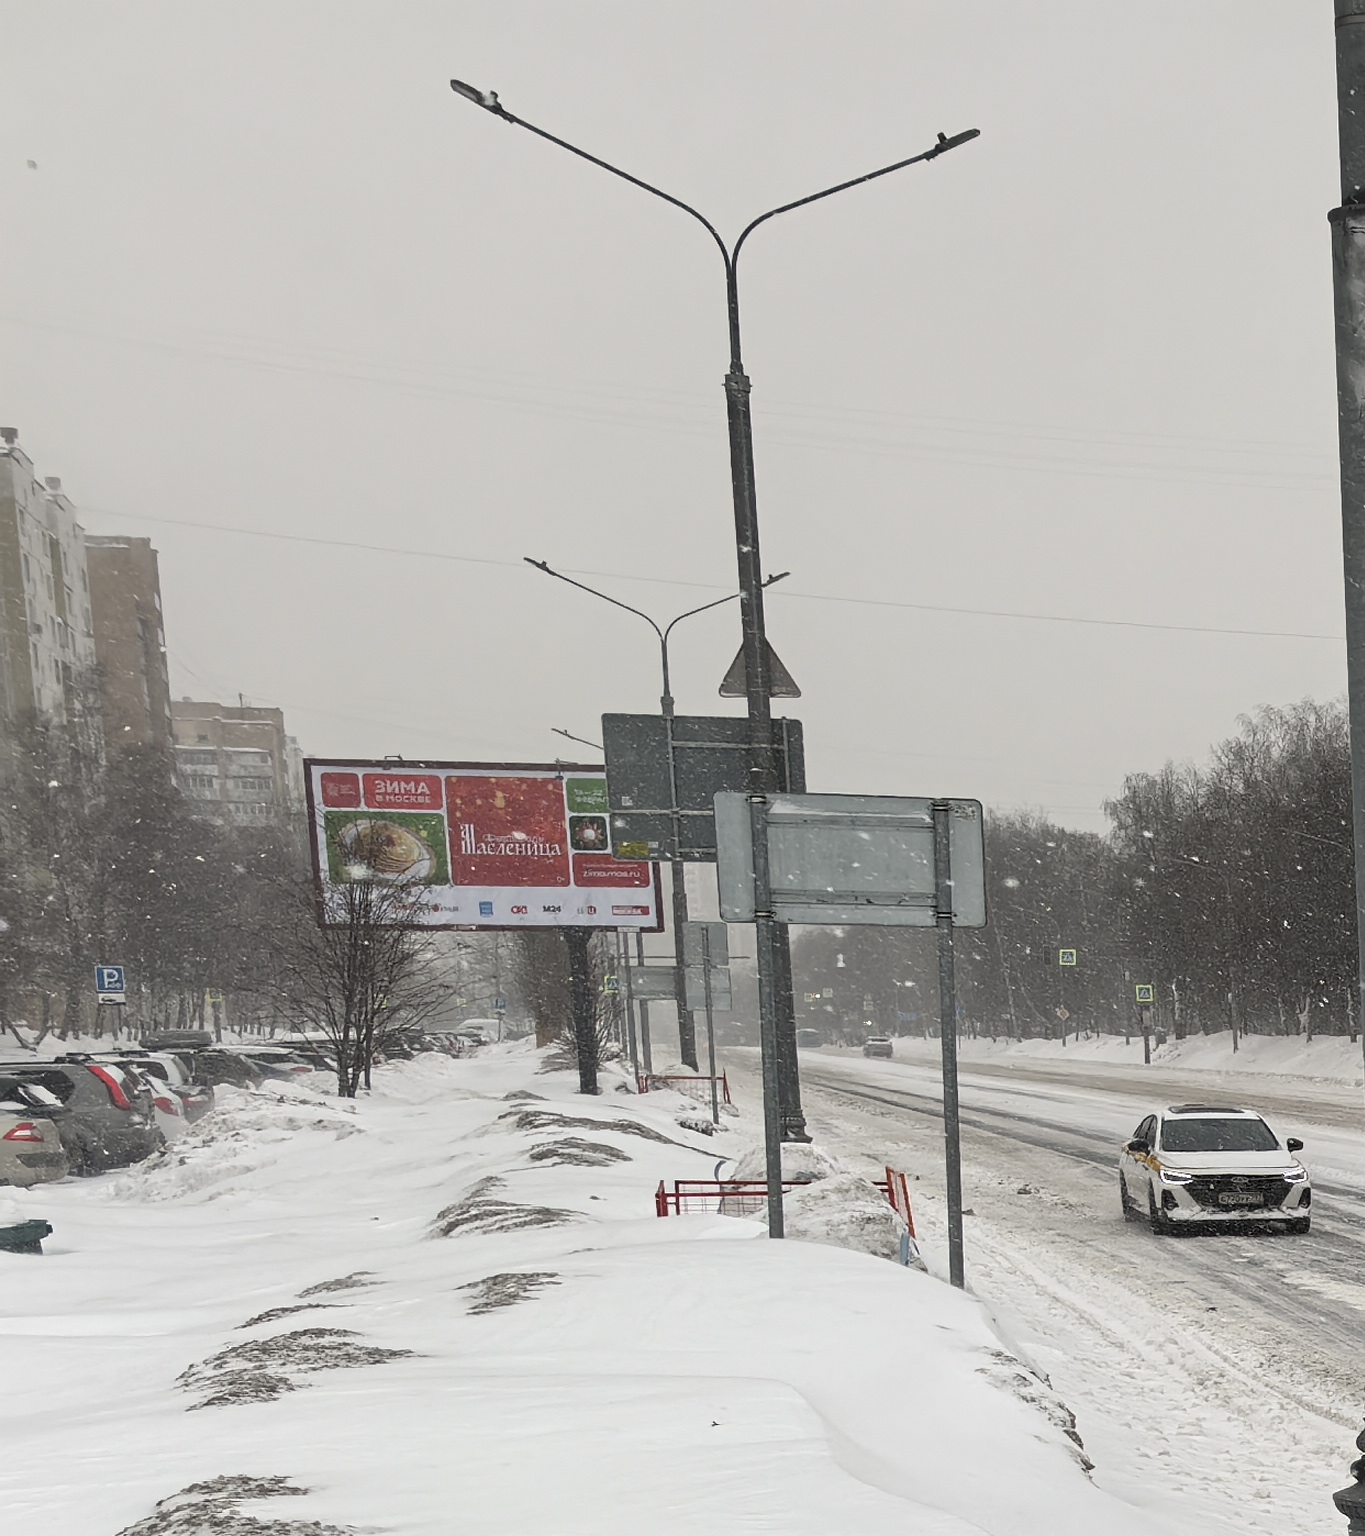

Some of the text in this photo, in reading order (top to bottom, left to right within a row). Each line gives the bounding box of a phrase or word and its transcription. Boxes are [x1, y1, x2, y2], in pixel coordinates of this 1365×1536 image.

[375, 780, 430, 794] ЗИМА
[376, 795, 430, 803] В МОСКВЕ
[461, 823, 562, 856] Масленица
